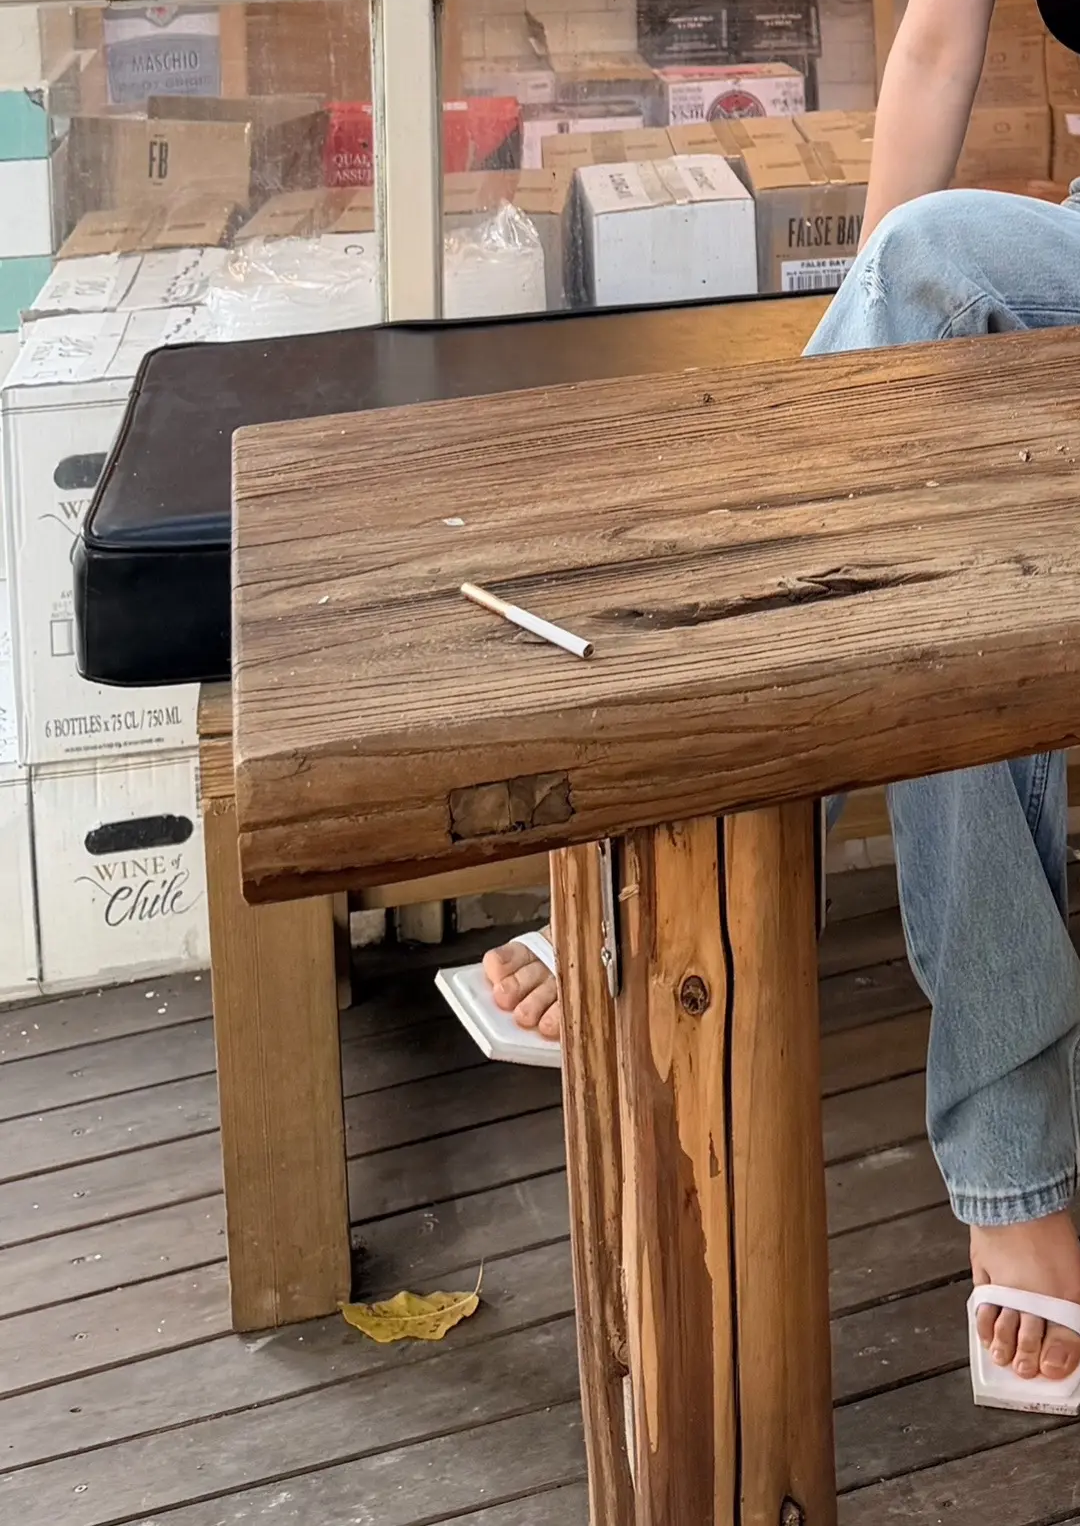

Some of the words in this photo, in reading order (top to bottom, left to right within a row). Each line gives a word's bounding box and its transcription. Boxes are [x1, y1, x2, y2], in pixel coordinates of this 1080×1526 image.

[132, 50, 198, 73] MASCHIO
[149, 141, 169, 179] FB
[788, 216, 833, 248] FALSE
[829, 259, 847, 267] BAY
[45, 719, 52, 738] 6
[54, 714, 101, 738] BOTTLES
[111, 713, 122, 732] 75
[124, 710, 140, 730] CL
[147, 707, 165, 728] 750
[166, 705, 182, 725] ML
[93, 855, 166, 882] WINE
[171, 853, 183, 870] of
[103, 868, 194, 927] Chile
